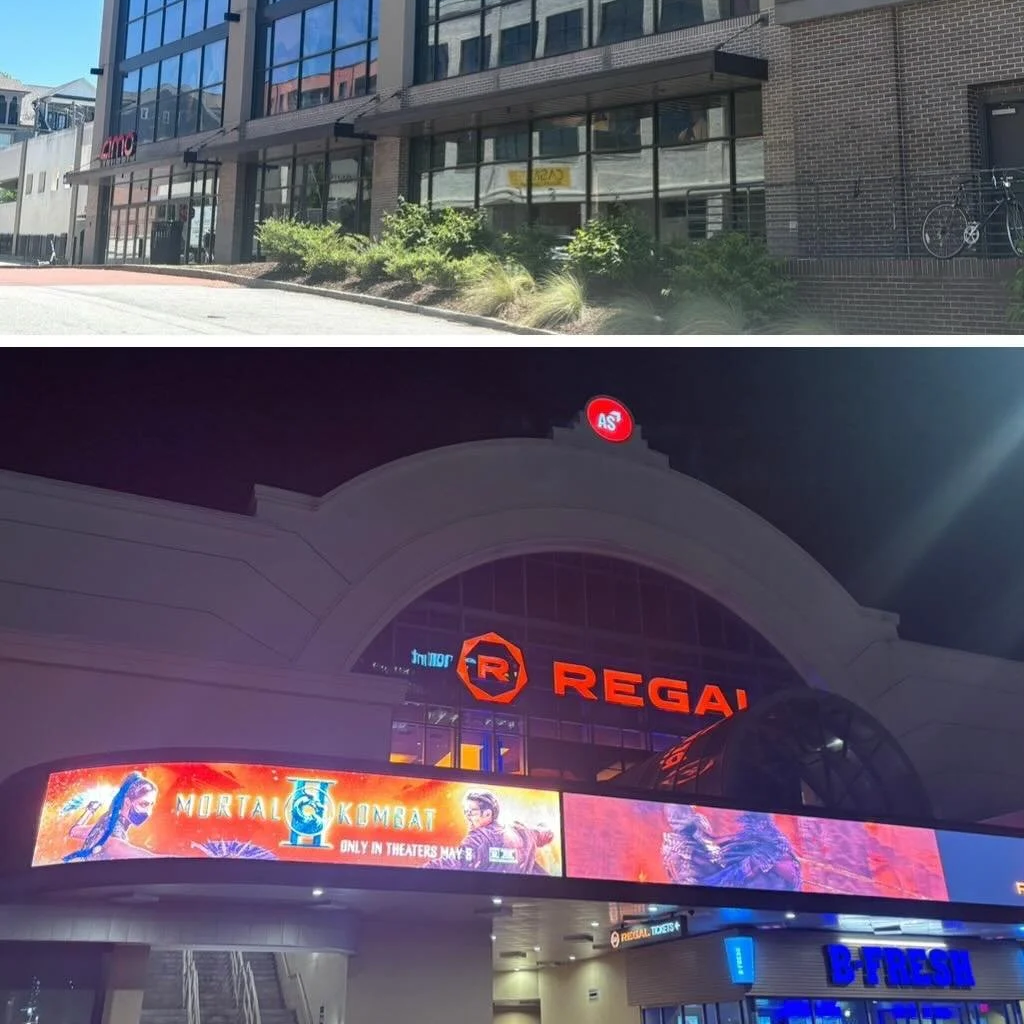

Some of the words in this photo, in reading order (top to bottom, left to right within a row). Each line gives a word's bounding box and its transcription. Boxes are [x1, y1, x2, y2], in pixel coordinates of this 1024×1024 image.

[175, 792, 281, 824] MORTAL
[337, 800, 437, 832] KOMBAT
[340, 839, 368, 855] ONLY
[371, 840, 382, 855] IN
[386, 841, 439, 859] THEATERS
[439, 846, 463, 861] MAY
[464, 847, 473, 861] 8
[621, 931, 651, 943] REGAL
[650, 922, 674, 936] TICKETS
[825, 943, 976, 988] B-FRESH
